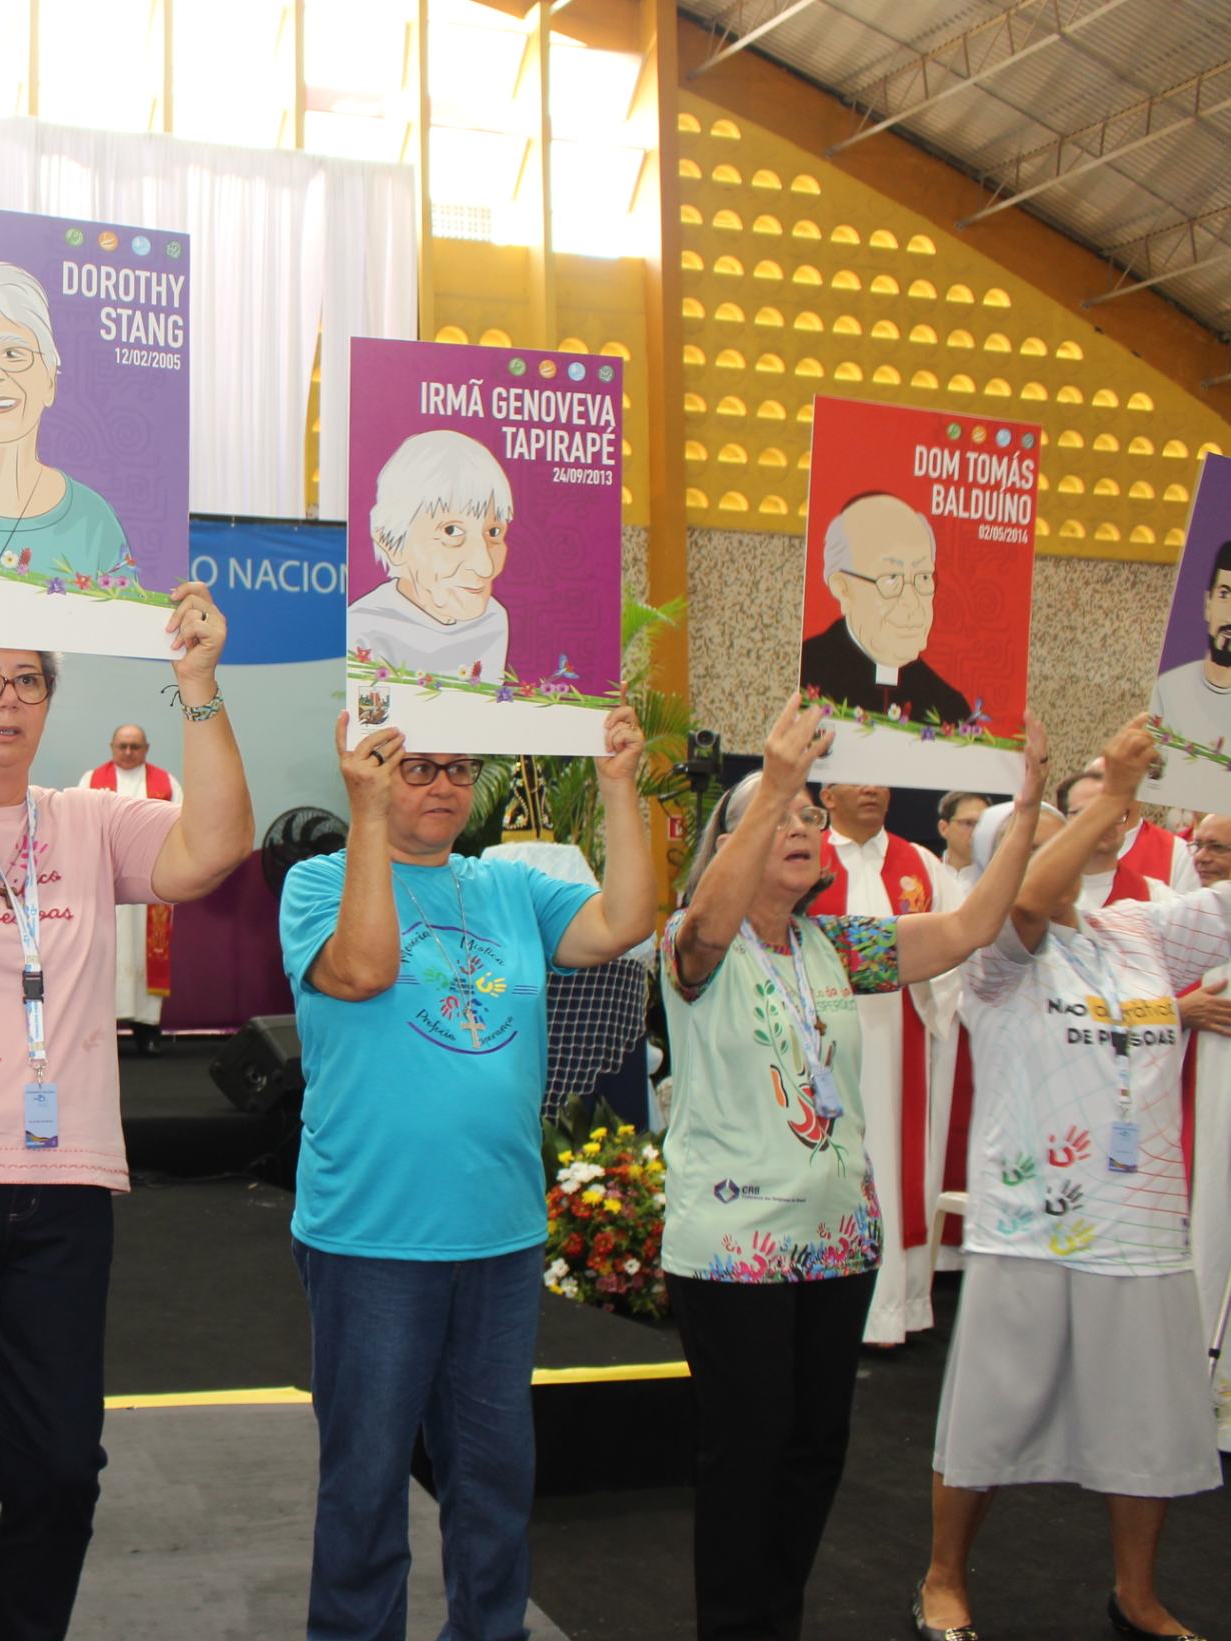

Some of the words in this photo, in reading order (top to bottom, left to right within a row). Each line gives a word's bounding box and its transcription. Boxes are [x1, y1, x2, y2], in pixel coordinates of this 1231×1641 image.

[62, 260, 185, 308] DOROTHY
[99, 306, 184, 349] STANG
[114, 347, 181, 370] 12/02/2005
[420, 379, 485, 418] IRMÃ
[491, 386, 616, 427] GENOVEVA
[501, 426, 616, 466] TAPIRAPÉ
[552, 467, 613, 486] 24/09/2013
[914, 444, 961, 482] DOM
[965, 450, 1035, 490] TOMÁS
[931, 484, 1033, 525] BALDUÍNO
[978, 523, 1029, 545] 02/05/2014
[1066, 1028, 1094, 1044] DE
[1098, 1029, 1177, 1047] PSOAS
